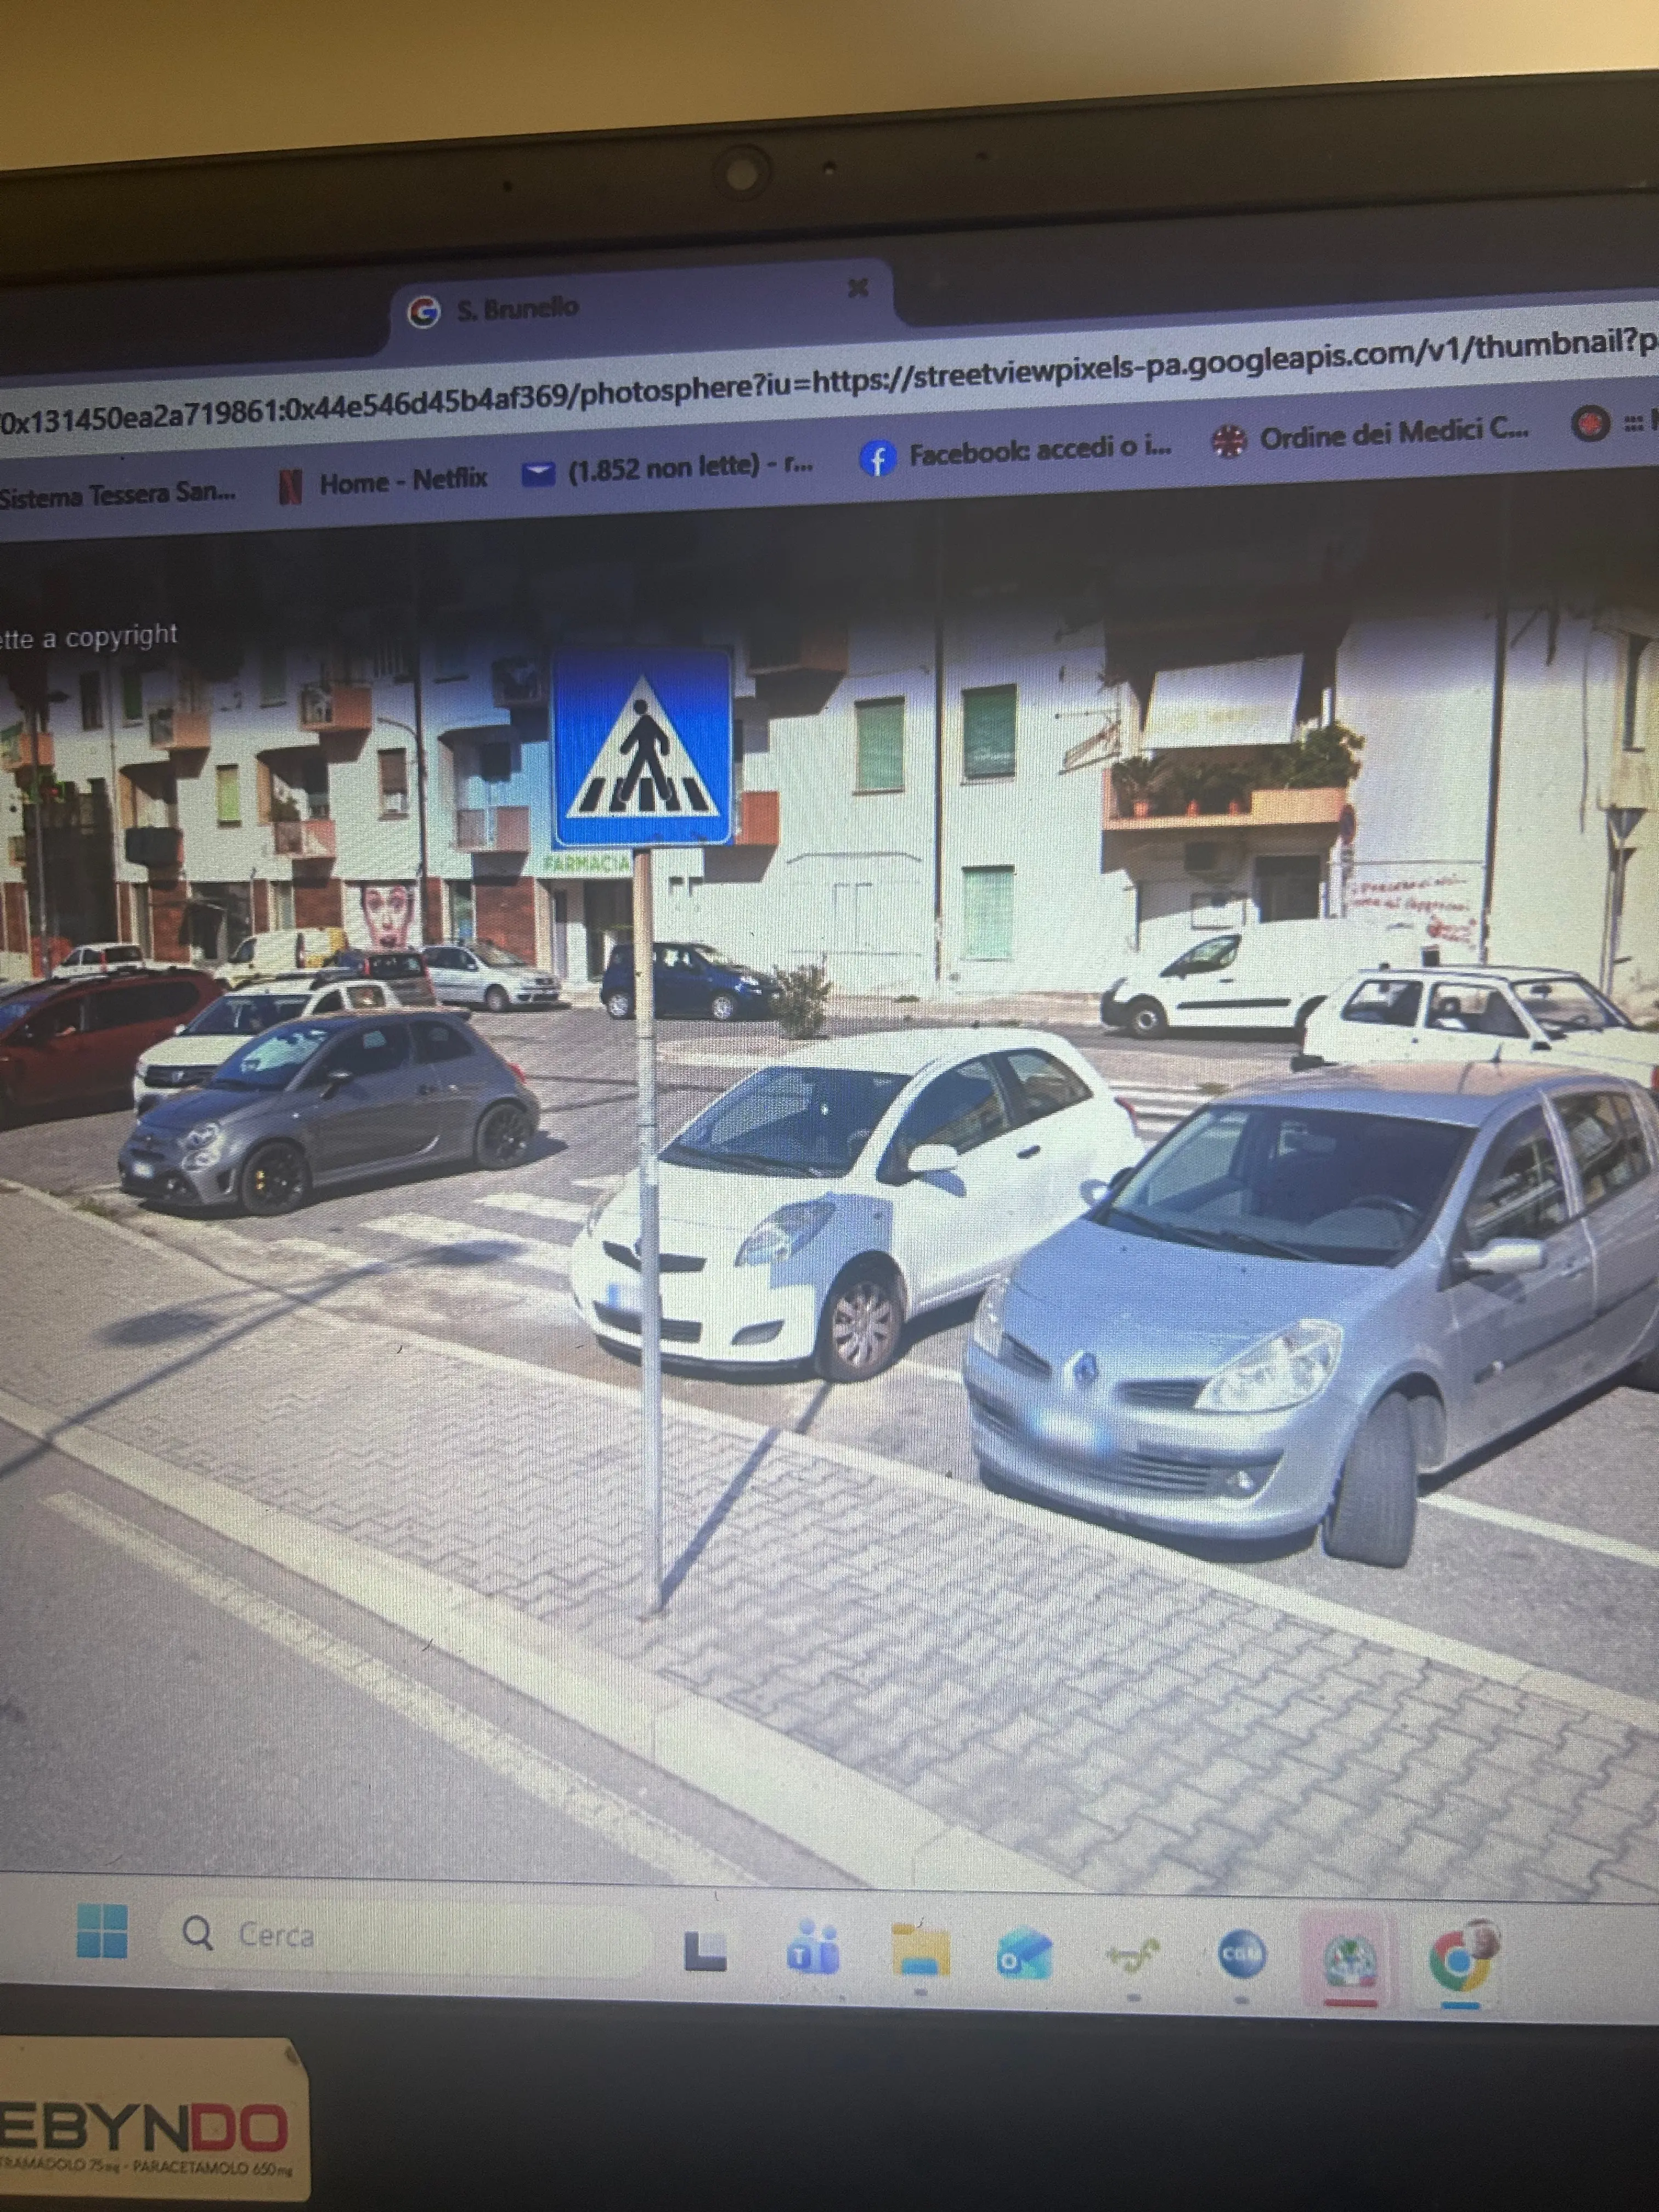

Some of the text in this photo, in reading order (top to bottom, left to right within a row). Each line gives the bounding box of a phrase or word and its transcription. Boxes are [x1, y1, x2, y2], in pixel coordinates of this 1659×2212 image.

[458, 296, 580, 322] S. Brunello
[1261, 415, 1530, 450] Ordine dei Medici C...
[911, 433, 1172, 466] Facebook: accedi o i...
[320, 473, 390, 496] Home
[414, 467, 488, 490] Netflix
[569, 458, 640, 487] (1.852
[647, 461, 692, 481] non
[699, 452, 760, 478] lette)
[784, 454, 814, 473] r...
[0, 481, 236, 511] Sistema Tessera San...
[0, 622, 179, 653] tte a copyright
[239, 1920, 314, 1948] Cerca
[0, 2100, 289, 2153] EBYNDO
[133, 2159, 249, 2176] PARACETAMOLO
[252, 2160, 294, 2178] 650mg
